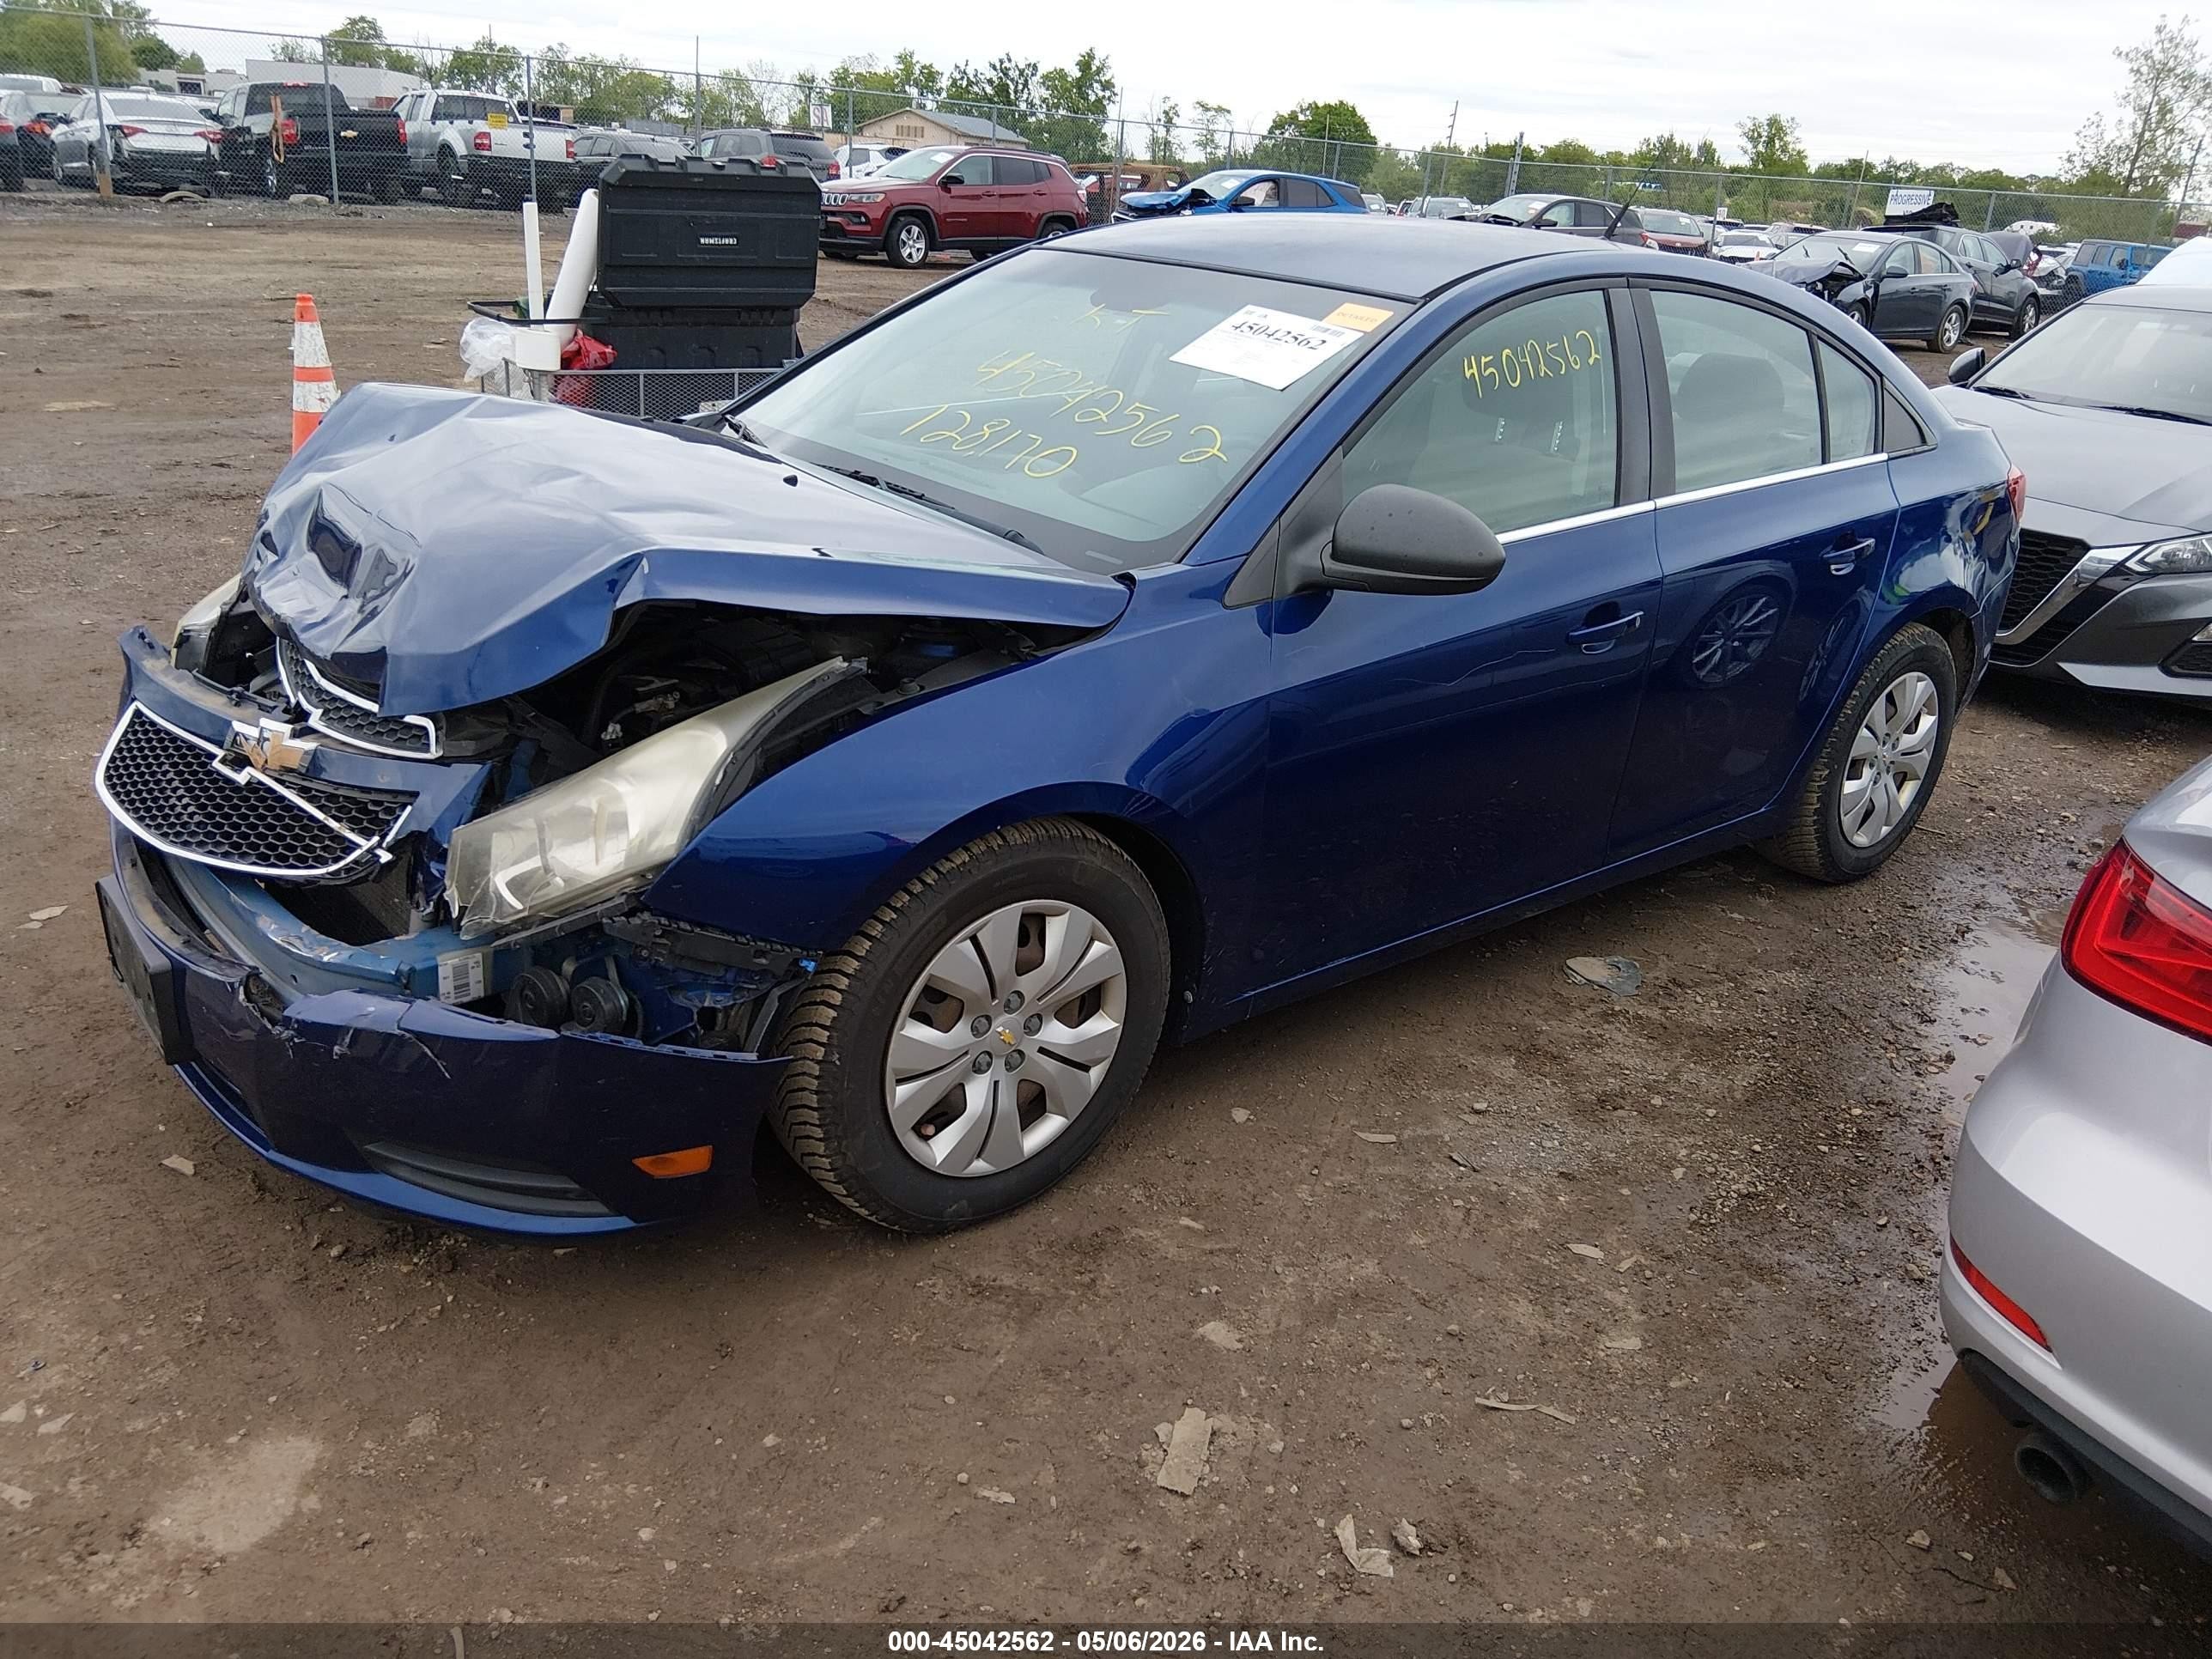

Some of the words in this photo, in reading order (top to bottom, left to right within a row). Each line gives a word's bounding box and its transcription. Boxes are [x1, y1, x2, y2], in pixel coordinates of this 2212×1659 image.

[1889, 193, 1932, 205] PROGRESSIVE
[1231, 321, 1328, 350] 45042562
[1462, 330, 1601, 398] 45042562
[973, 350, 1229, 464] 45042562
